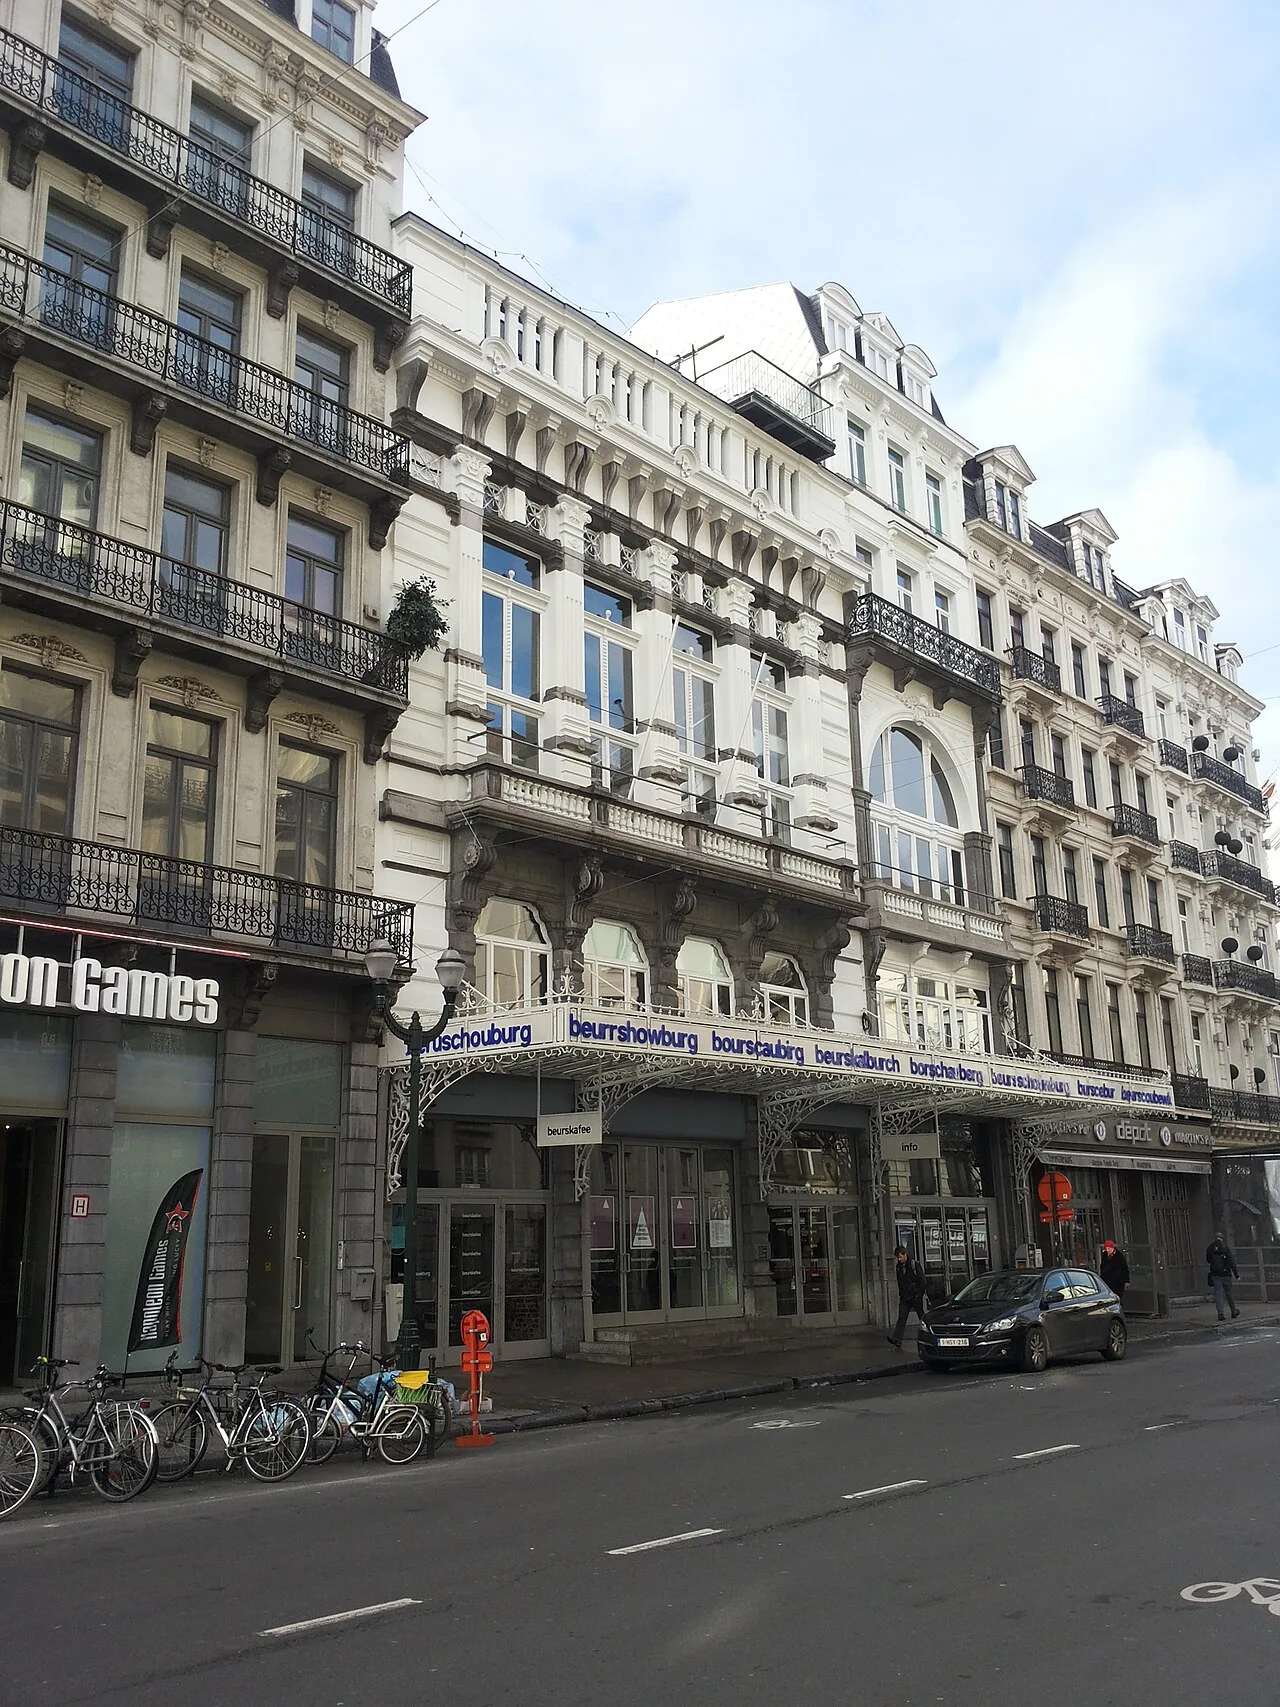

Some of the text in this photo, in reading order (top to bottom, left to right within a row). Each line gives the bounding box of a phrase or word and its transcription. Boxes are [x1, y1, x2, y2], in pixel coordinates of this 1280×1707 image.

[72, 957, 220, 1024] Games
[547, 1124, 591, 1136] beurskafee
[901, 1142, 918, 1151] info
[75, 1199, 86, 1214] H
[148, 1239, 169, 1281] Games
